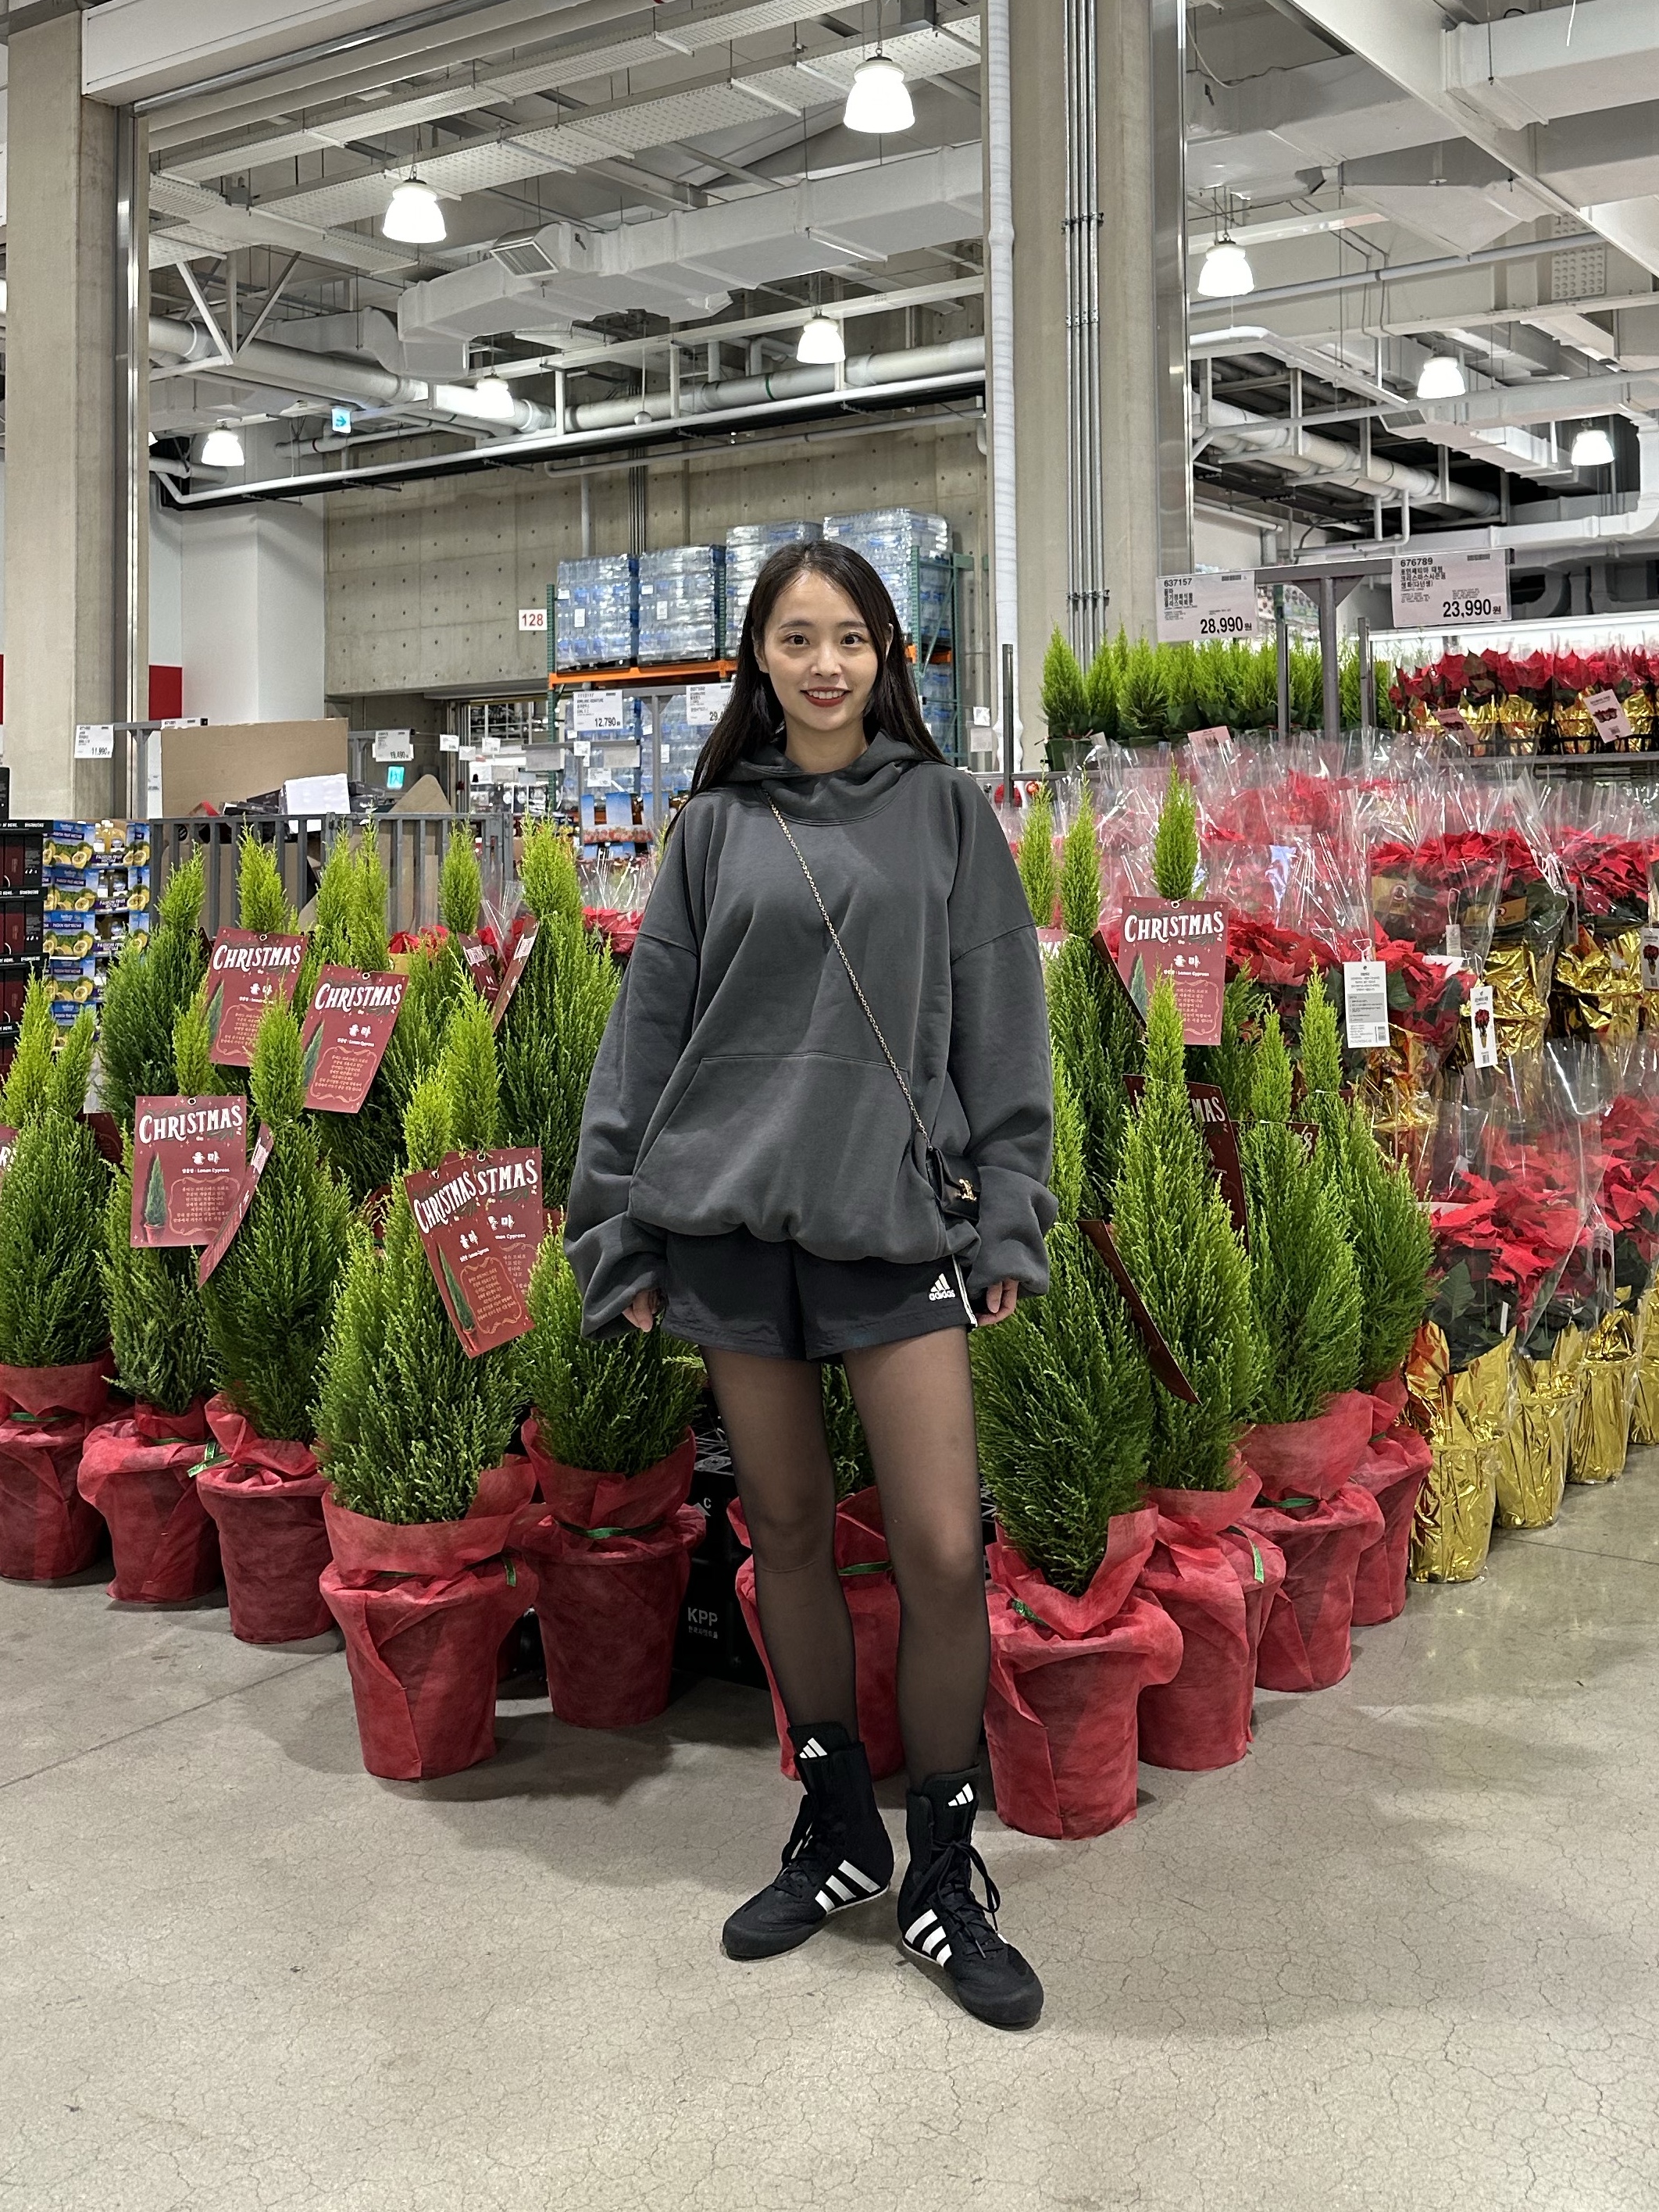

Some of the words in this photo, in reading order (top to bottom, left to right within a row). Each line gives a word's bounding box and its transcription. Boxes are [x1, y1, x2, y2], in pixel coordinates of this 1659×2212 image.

[1400, 557, 1433, 567] 676789
[1164, 578, 1192, 587] 637157
[522, 613, 544, 626] 128
[1124, 911, 1224, 943] CHRISTMAS
[212, 944, 301, 972] CHRISTMAS
[1173, 954, 1201, 969] 율마
[315, 983, 402, 1012] CHRISTMAS
[138, 1104, 243, 1143] CHRISTMAS
[192, 1151, 220, 1165] 율마
[477, 1158, 538, 1196] STMAS
[413, 1171, 477, 1234] CHRISTMAS
[929, 1290, 955, 1301] adidas
[687, 1607, 718, 1627] KPP
